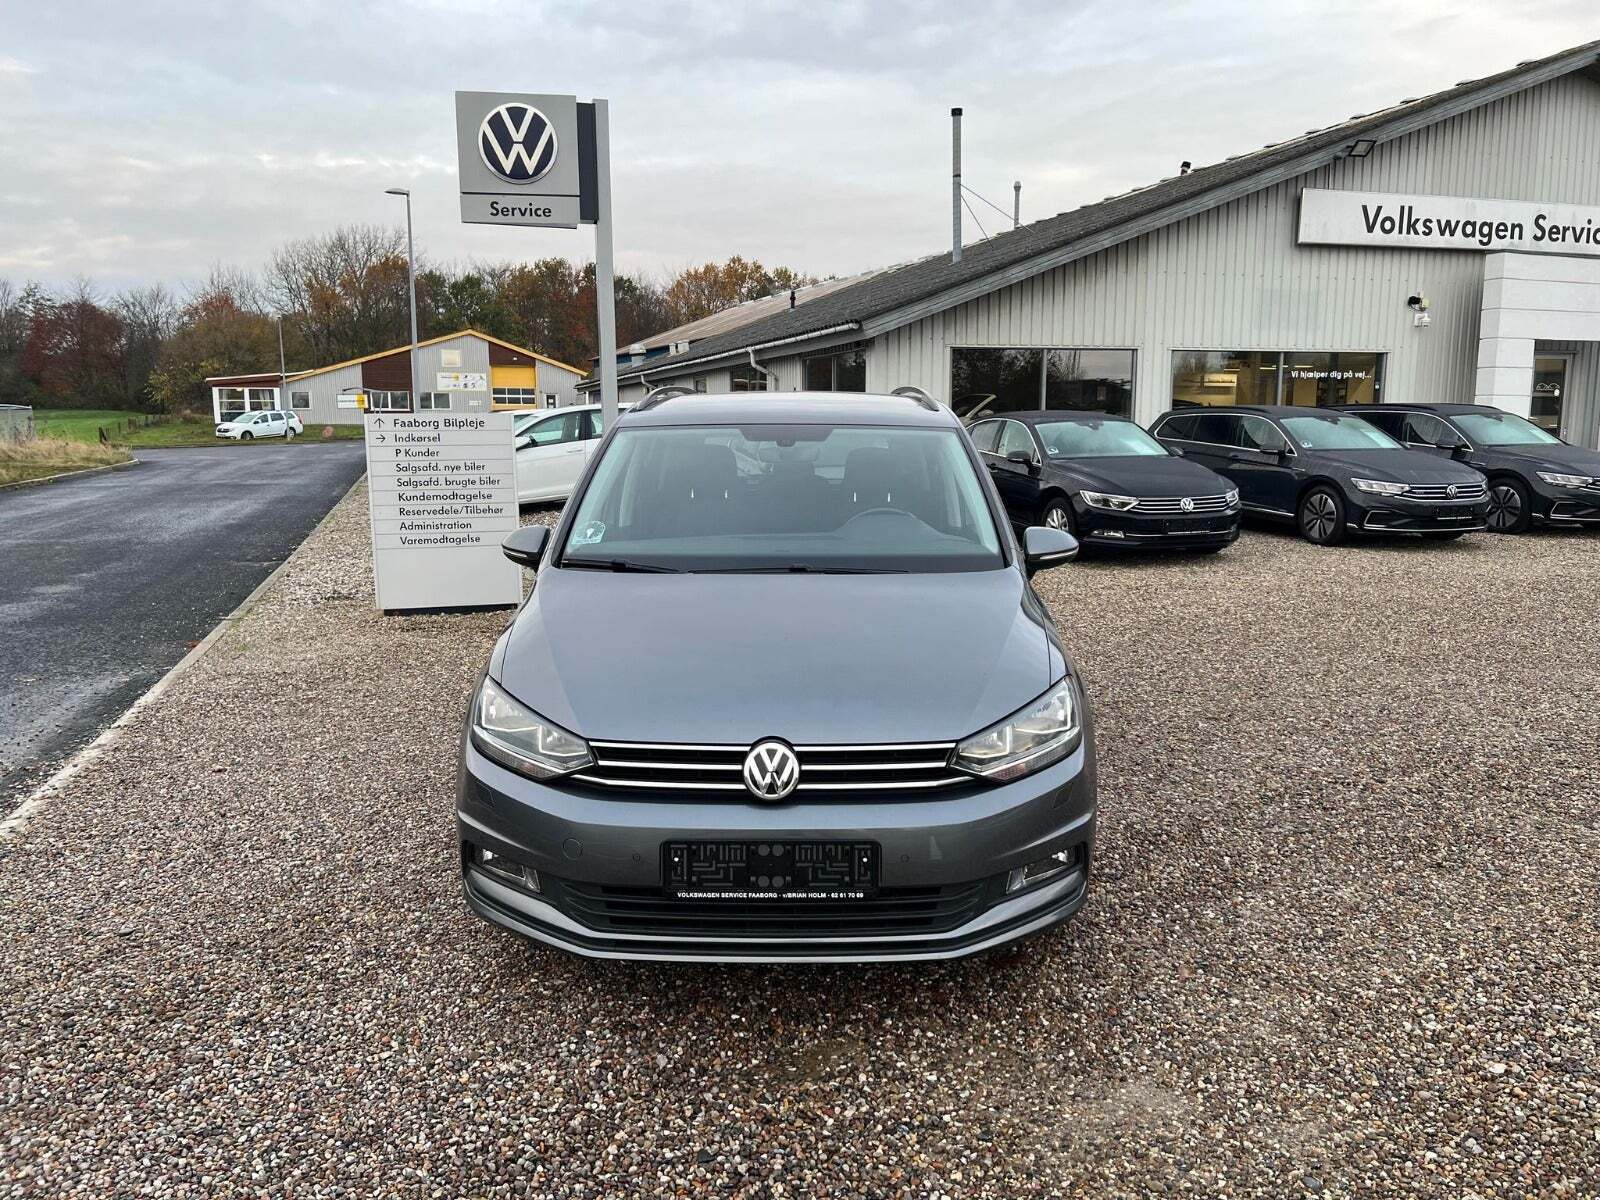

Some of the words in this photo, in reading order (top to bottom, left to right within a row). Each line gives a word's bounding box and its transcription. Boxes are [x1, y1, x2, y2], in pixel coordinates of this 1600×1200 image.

[479, 103, 557, 184] VW
[490, 201, 552, 217] Service
[1361, 205, 1524, 246] Volkswagen
[1300, 371, 1328, 379] hjælper
[1330, 371, 1341, 379] dig
[1344, 370, 1352, 379] på
[393, 418, 440, 430] Faaborg
[444, 418, 485, 430] Bilpleje
[394, 433, 440, 443] Indkørsel
[395, 448, 401, 457] P
[404, 448, 440, 457] Kunder
[396, 462, 440, 474] Salgsafd.
[444, 464, 461, 473] nye
[464, 461, 485, 471] biler
[397, 477, 442, 488] Salgsafd.
[445, 477, 476, 488] brugte
[479, 476, 500, 486] biler
[398, 490, 492, 502] Kundemodtagelse
[400, 505, 503, 516] Reservedele/Tilbehør
[400, 520, 472, 531] Administration
[400, 534, 480, 545] Varemodtagelse
[743, 742, 800, 800] VW
